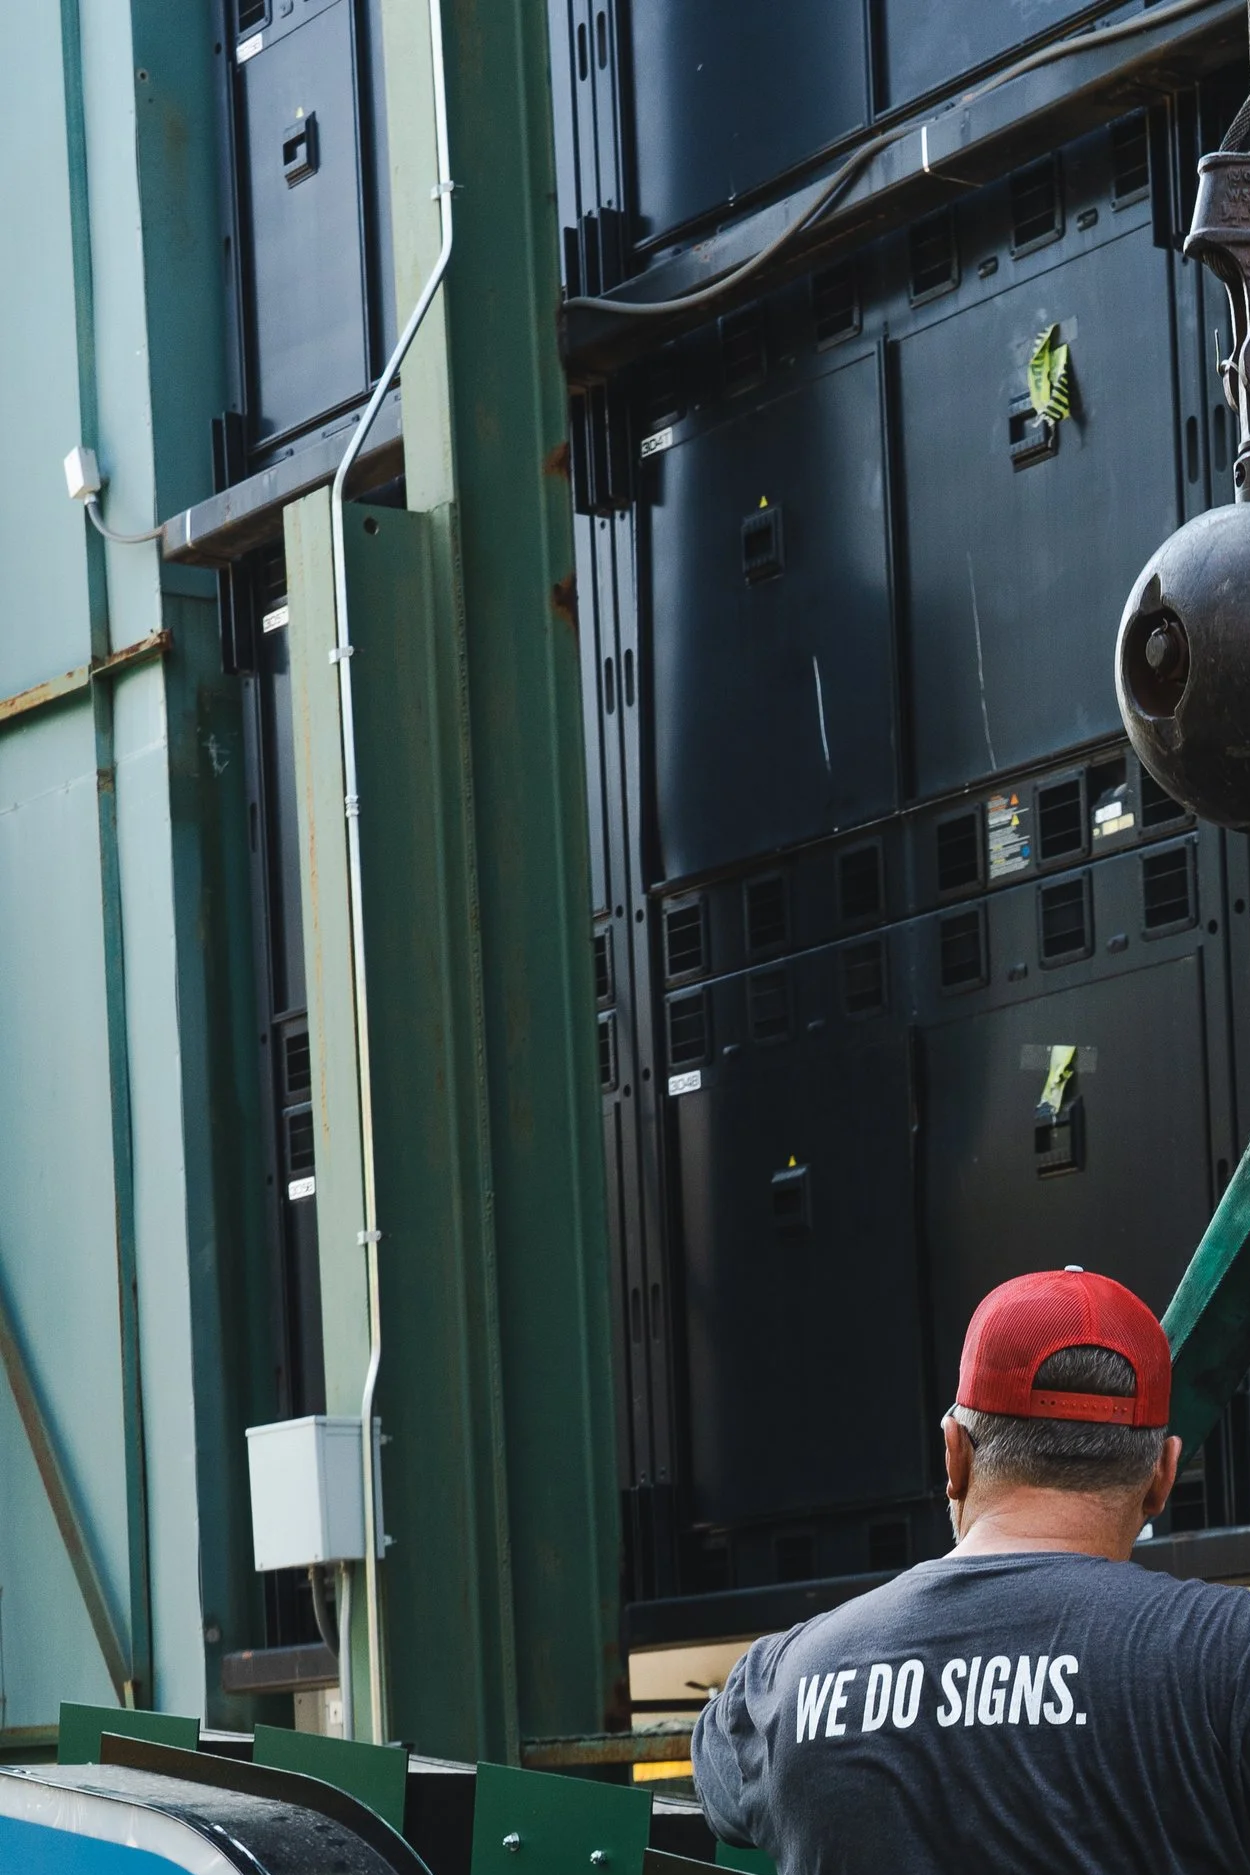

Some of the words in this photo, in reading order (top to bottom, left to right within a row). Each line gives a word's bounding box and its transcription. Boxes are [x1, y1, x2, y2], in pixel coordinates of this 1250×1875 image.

[796, 1669, 857, 1743] WE
[861, 1659, 924, 1733] DO
[936, 1655, 1087, 1727] SIGNS.
